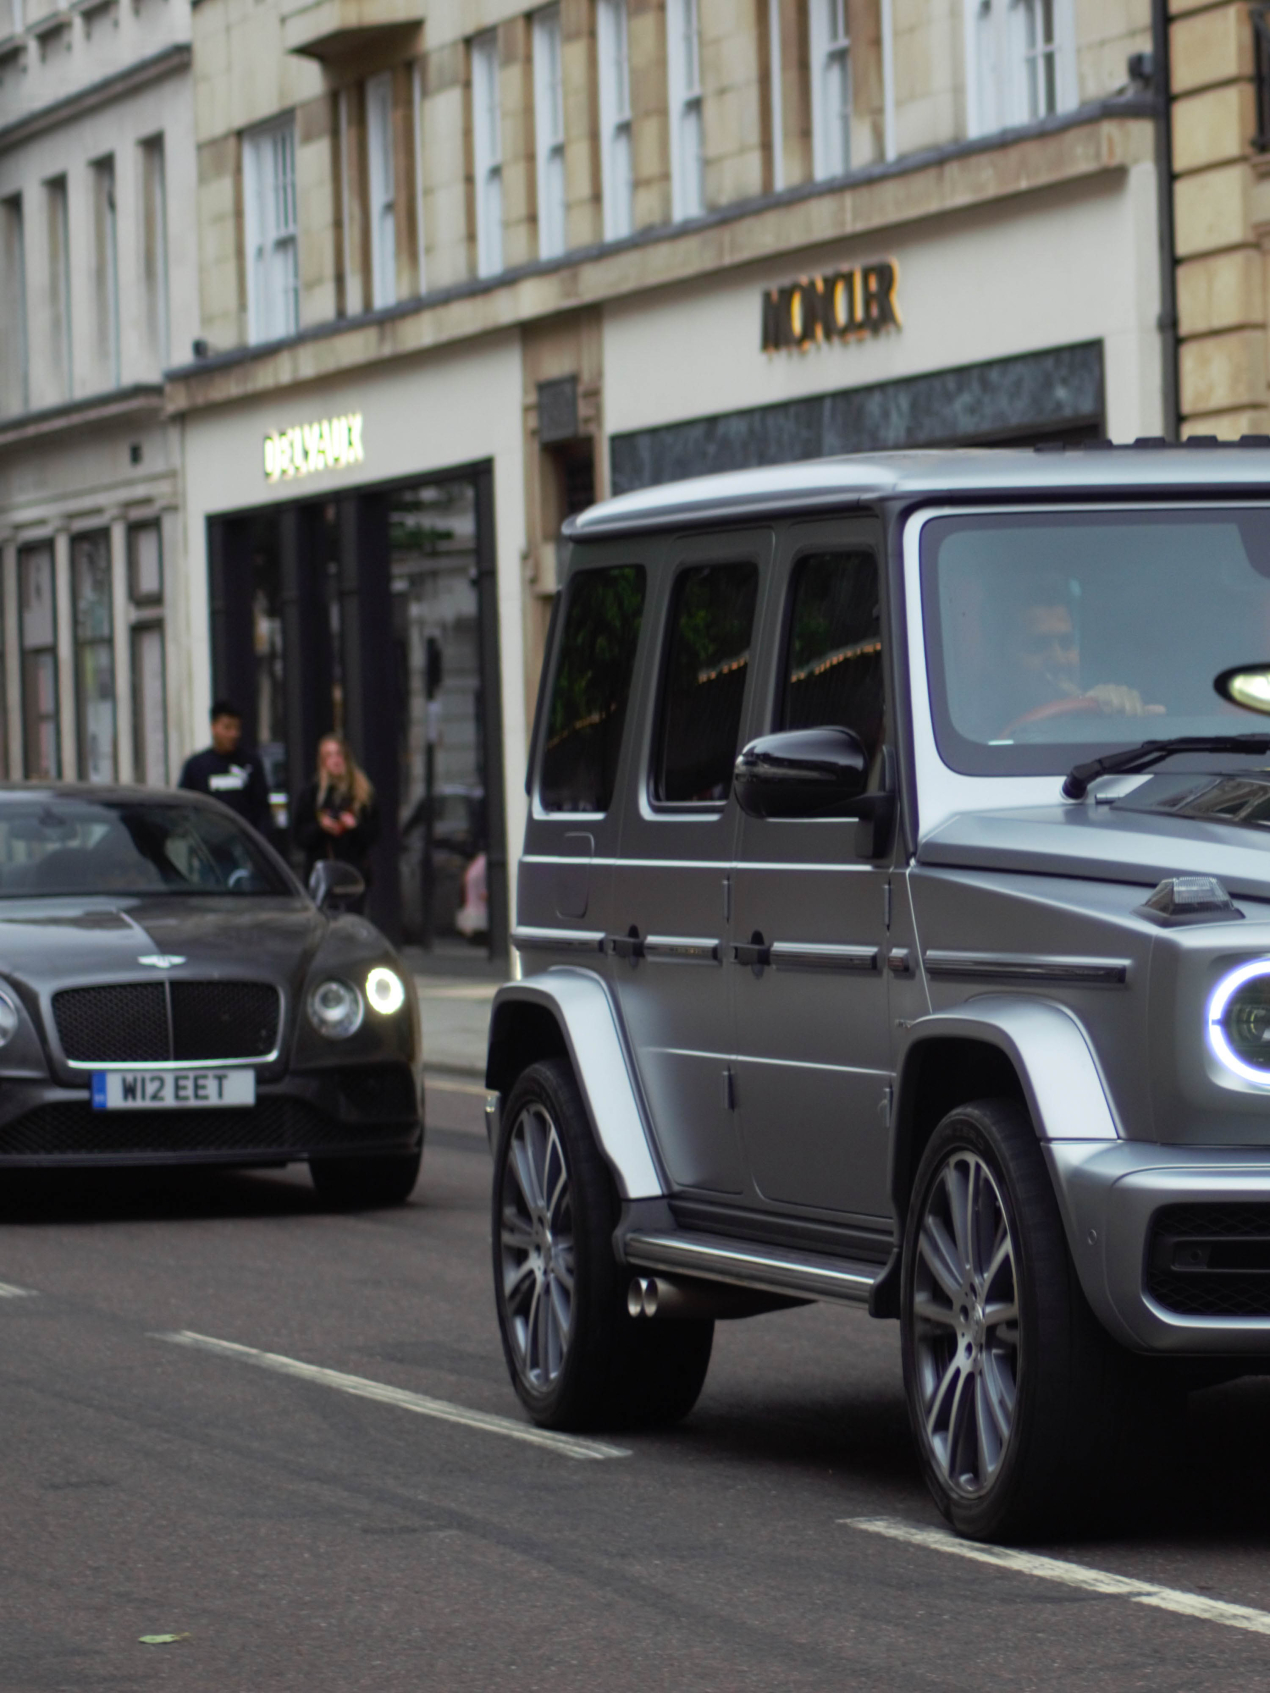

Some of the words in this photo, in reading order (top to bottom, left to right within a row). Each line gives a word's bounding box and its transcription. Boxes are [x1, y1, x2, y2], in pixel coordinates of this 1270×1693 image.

[761, 260, 902, 352] MONCLER
[122, 1074, 166, 1102] W12
[174, 1074, 228, 1101] EET
